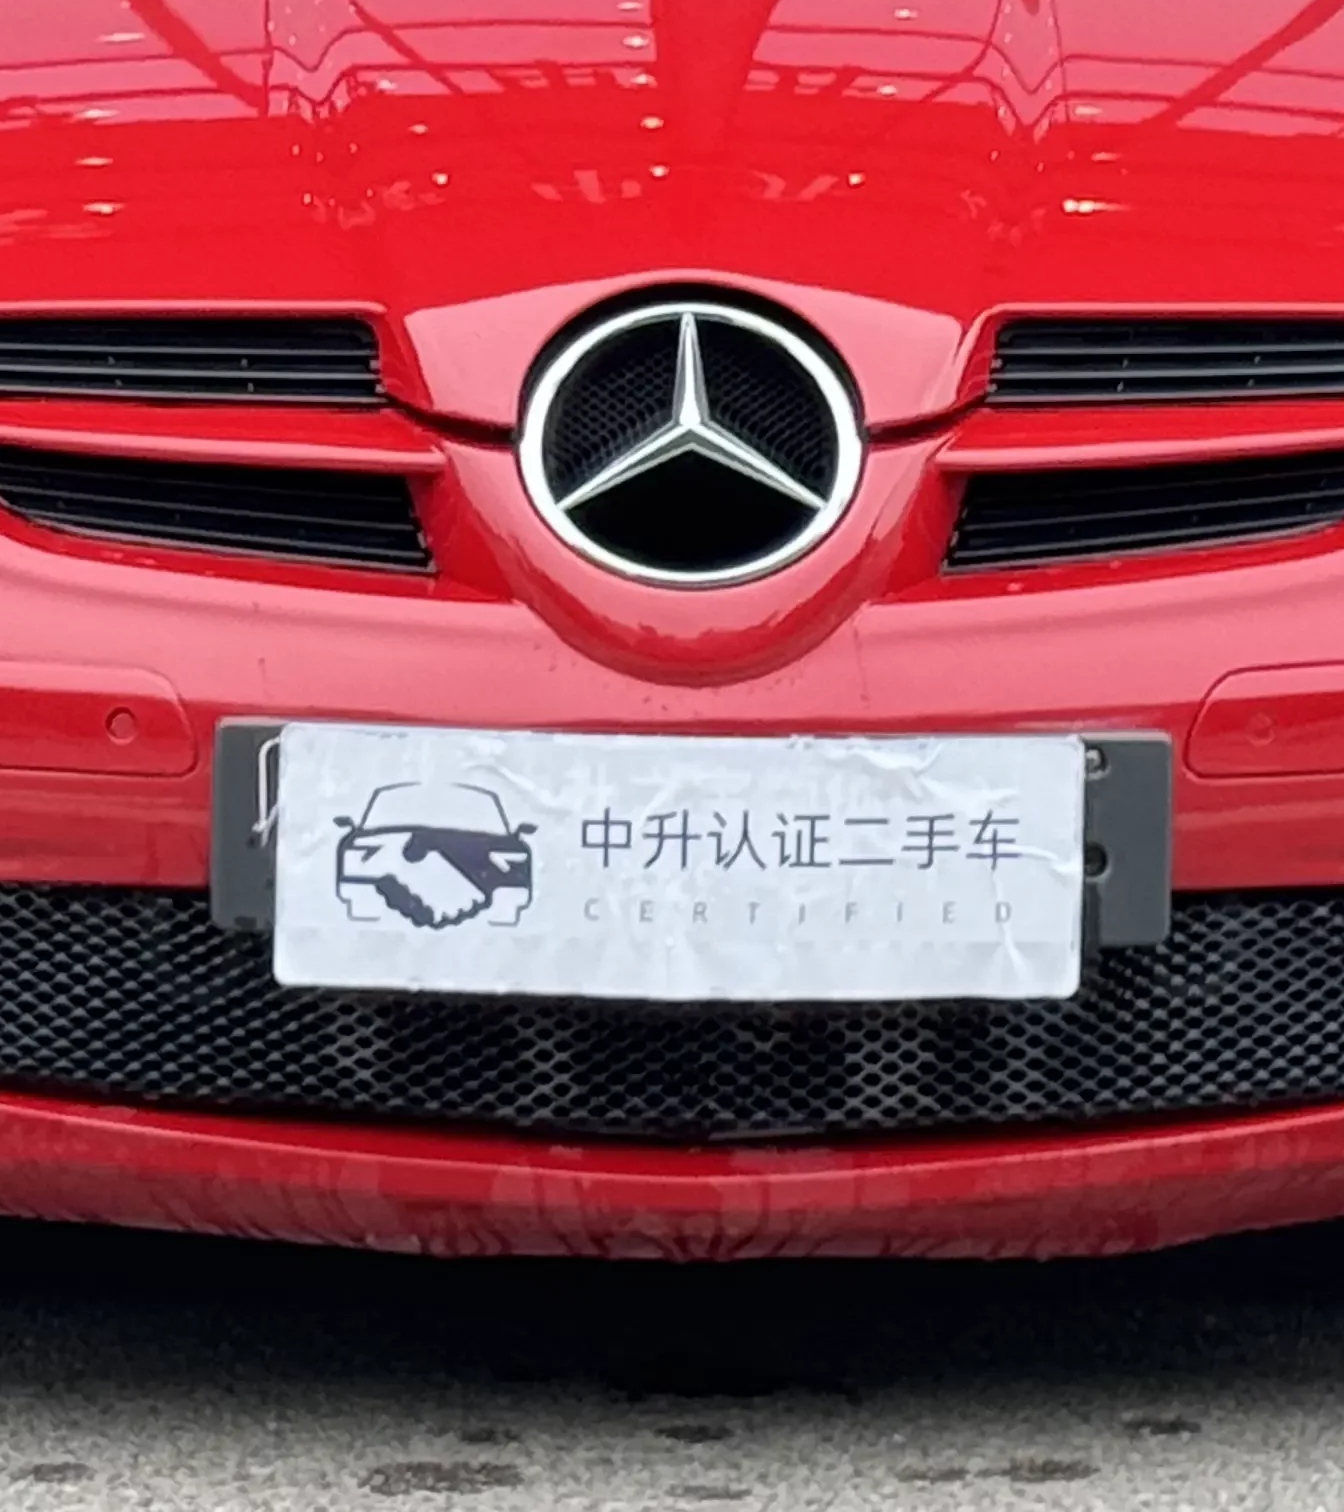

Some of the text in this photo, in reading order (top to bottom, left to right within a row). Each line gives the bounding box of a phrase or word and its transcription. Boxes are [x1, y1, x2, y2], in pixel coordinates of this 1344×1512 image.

[580, 806, 1023, 872] 中升认证二手车
[583, 898, 1013, 925] CERTIFIED
